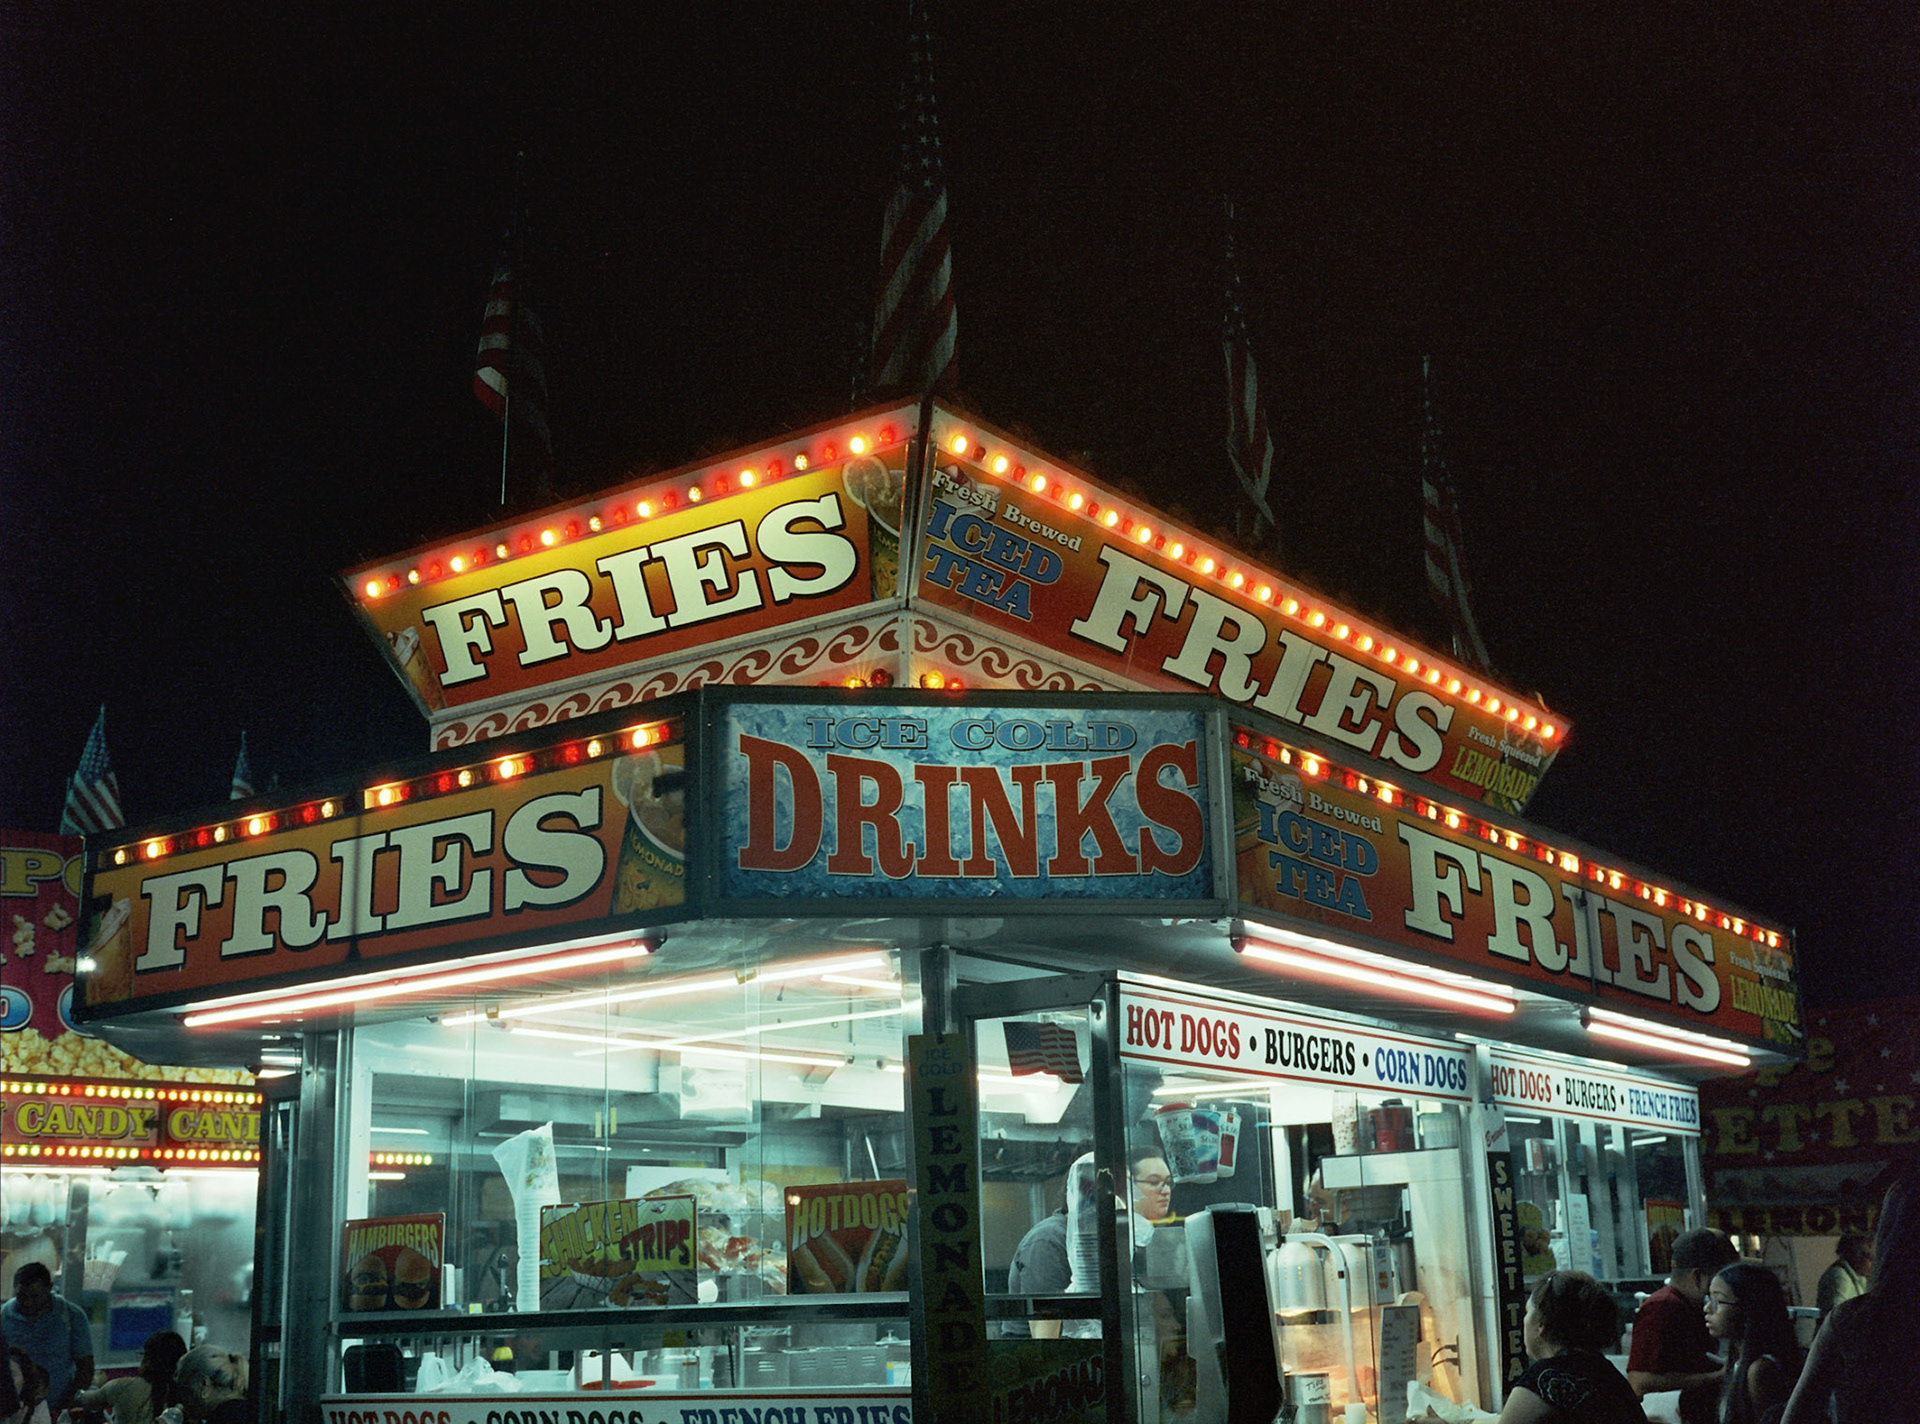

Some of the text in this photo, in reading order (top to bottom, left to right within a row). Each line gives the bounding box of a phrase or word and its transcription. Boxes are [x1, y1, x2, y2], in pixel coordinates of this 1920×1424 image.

[926, 499, 1063, 585] ICED
[933, 470, 1082, 552] Fresh Brewed
[422, 493, 858, 687] FRIES
[925, 543, 1033, 621] TEA
[1069, 544, 1455, 773] FRIES
[806, 717, 1137, 751] ICE COLD
[1468, 726, 1541, 767] Fresh Squeezed
[739, 733, 1204, 880] DRINKS
[1244, 766, 1383, 834] Fresh Brewed
[1450, 745, 1537, 802] LEMONADE
[1255, 798, 1379, 877] ICED
[135, 785, 604, 974] FRIES
[1269, 850, 1372, 922] TEA
[1398, 821, 1720, 1012] FRIES
[1729, 973, 1798, 1024] LEMONADE
[919, 1062, 963, 1077] COLD
[925, 1048, 951, 1061] ICE
[1127, 1004, 1466, 1091] HOT DOGS BURGERS CORN DOGS
[16, 1101, 156, 1139] CANDY
[1490, 1064, 1696, 1124] HOT DOGS BURGERS FRENCH FRIES
[346, 1223, 439, 1273] HAMBURGERS
[541, 1201, 637, 1276] CHICKEN
[619, 1219, 690, 1265] STRIPS
[926, 1086, 978, 1393] LEMONADE
[1494, 1161, 1517, 1290] SWEET
[1507, 1303, 1525, 1381] TEA
